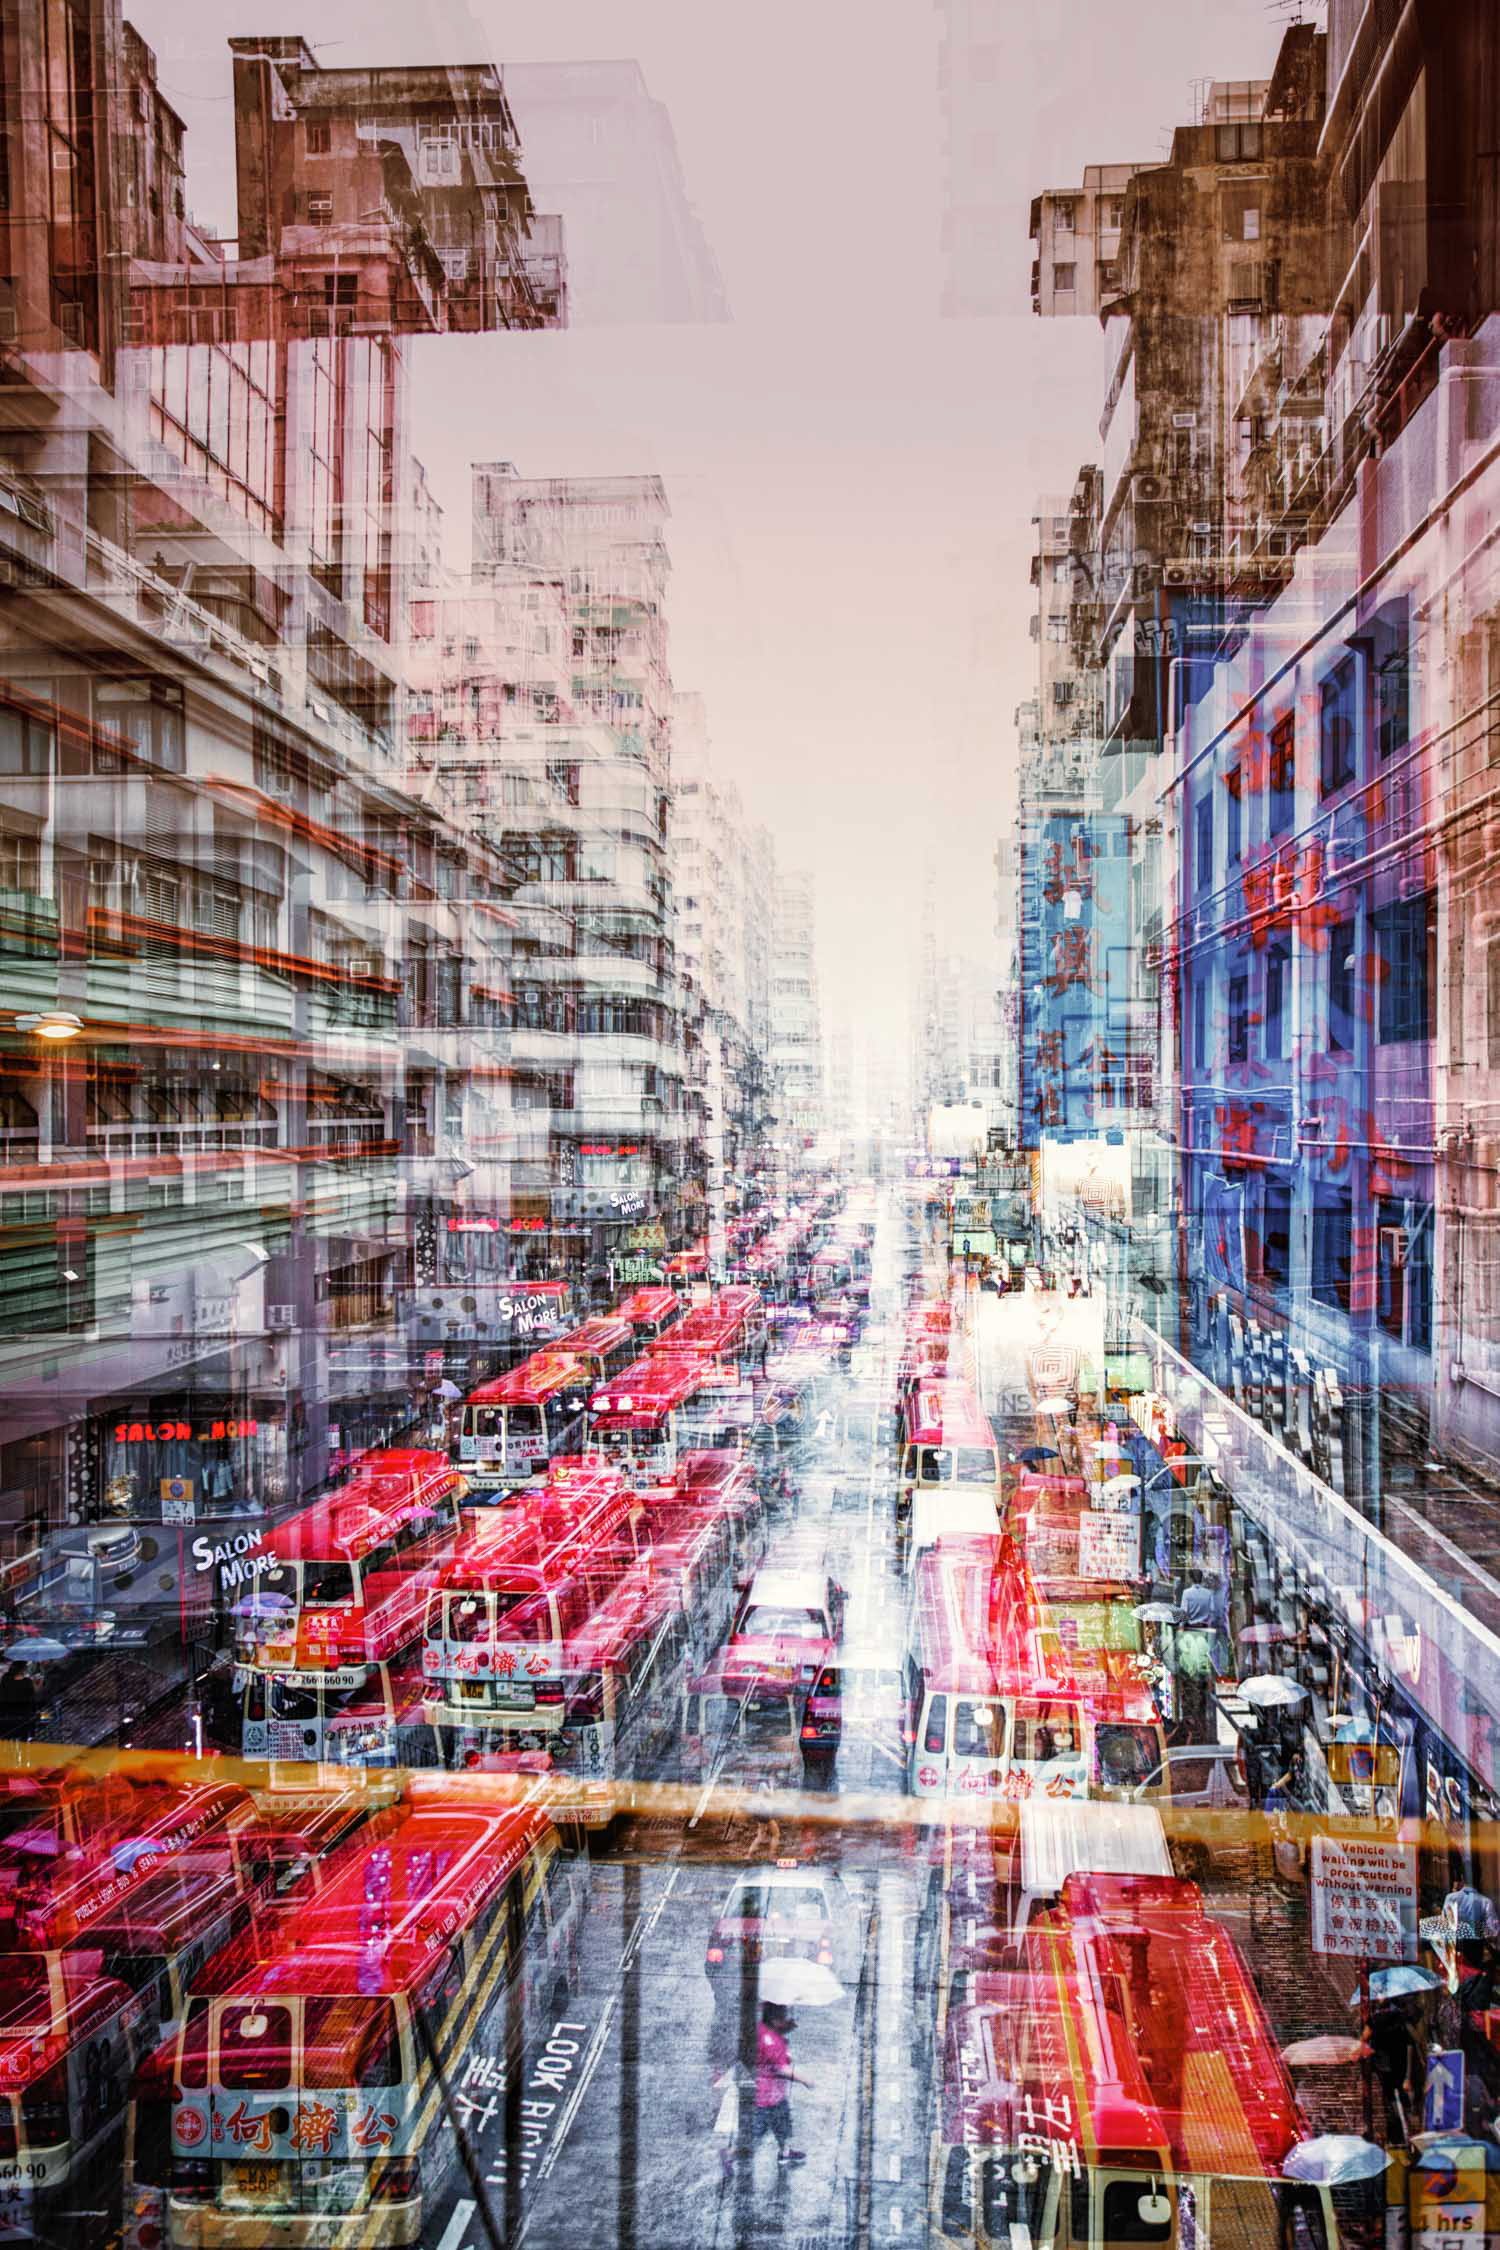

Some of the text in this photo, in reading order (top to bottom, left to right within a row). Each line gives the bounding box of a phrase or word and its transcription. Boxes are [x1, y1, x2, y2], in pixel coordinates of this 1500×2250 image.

[610, 1192, 639, 1207] SALON
[621, 1200, 645, 1215] MORE
[499, 1293, 547, 1321] SALON
[518, 1307, 558, 1333] MORE
[115, 1423, 192, 1442] SALON
[192, 1529, 262, 1571] SALON
[220, 1551, 279, 1589] MORE
[1341, 1843, 1385, 1855] Vehicle
[1321, 1855, 1406, 1869] waiting will be
[1316, 1878, 1412, 1896] without warning
[75, 1899, 98, 1922] PUBLIC
[529, 2022, 586, 2092] LOOK
[226, 2101, 398, 2154] 何濟公
[28, 2162, 46, 2178] 90
[1437, 2213, 1473, 2232] hrs
